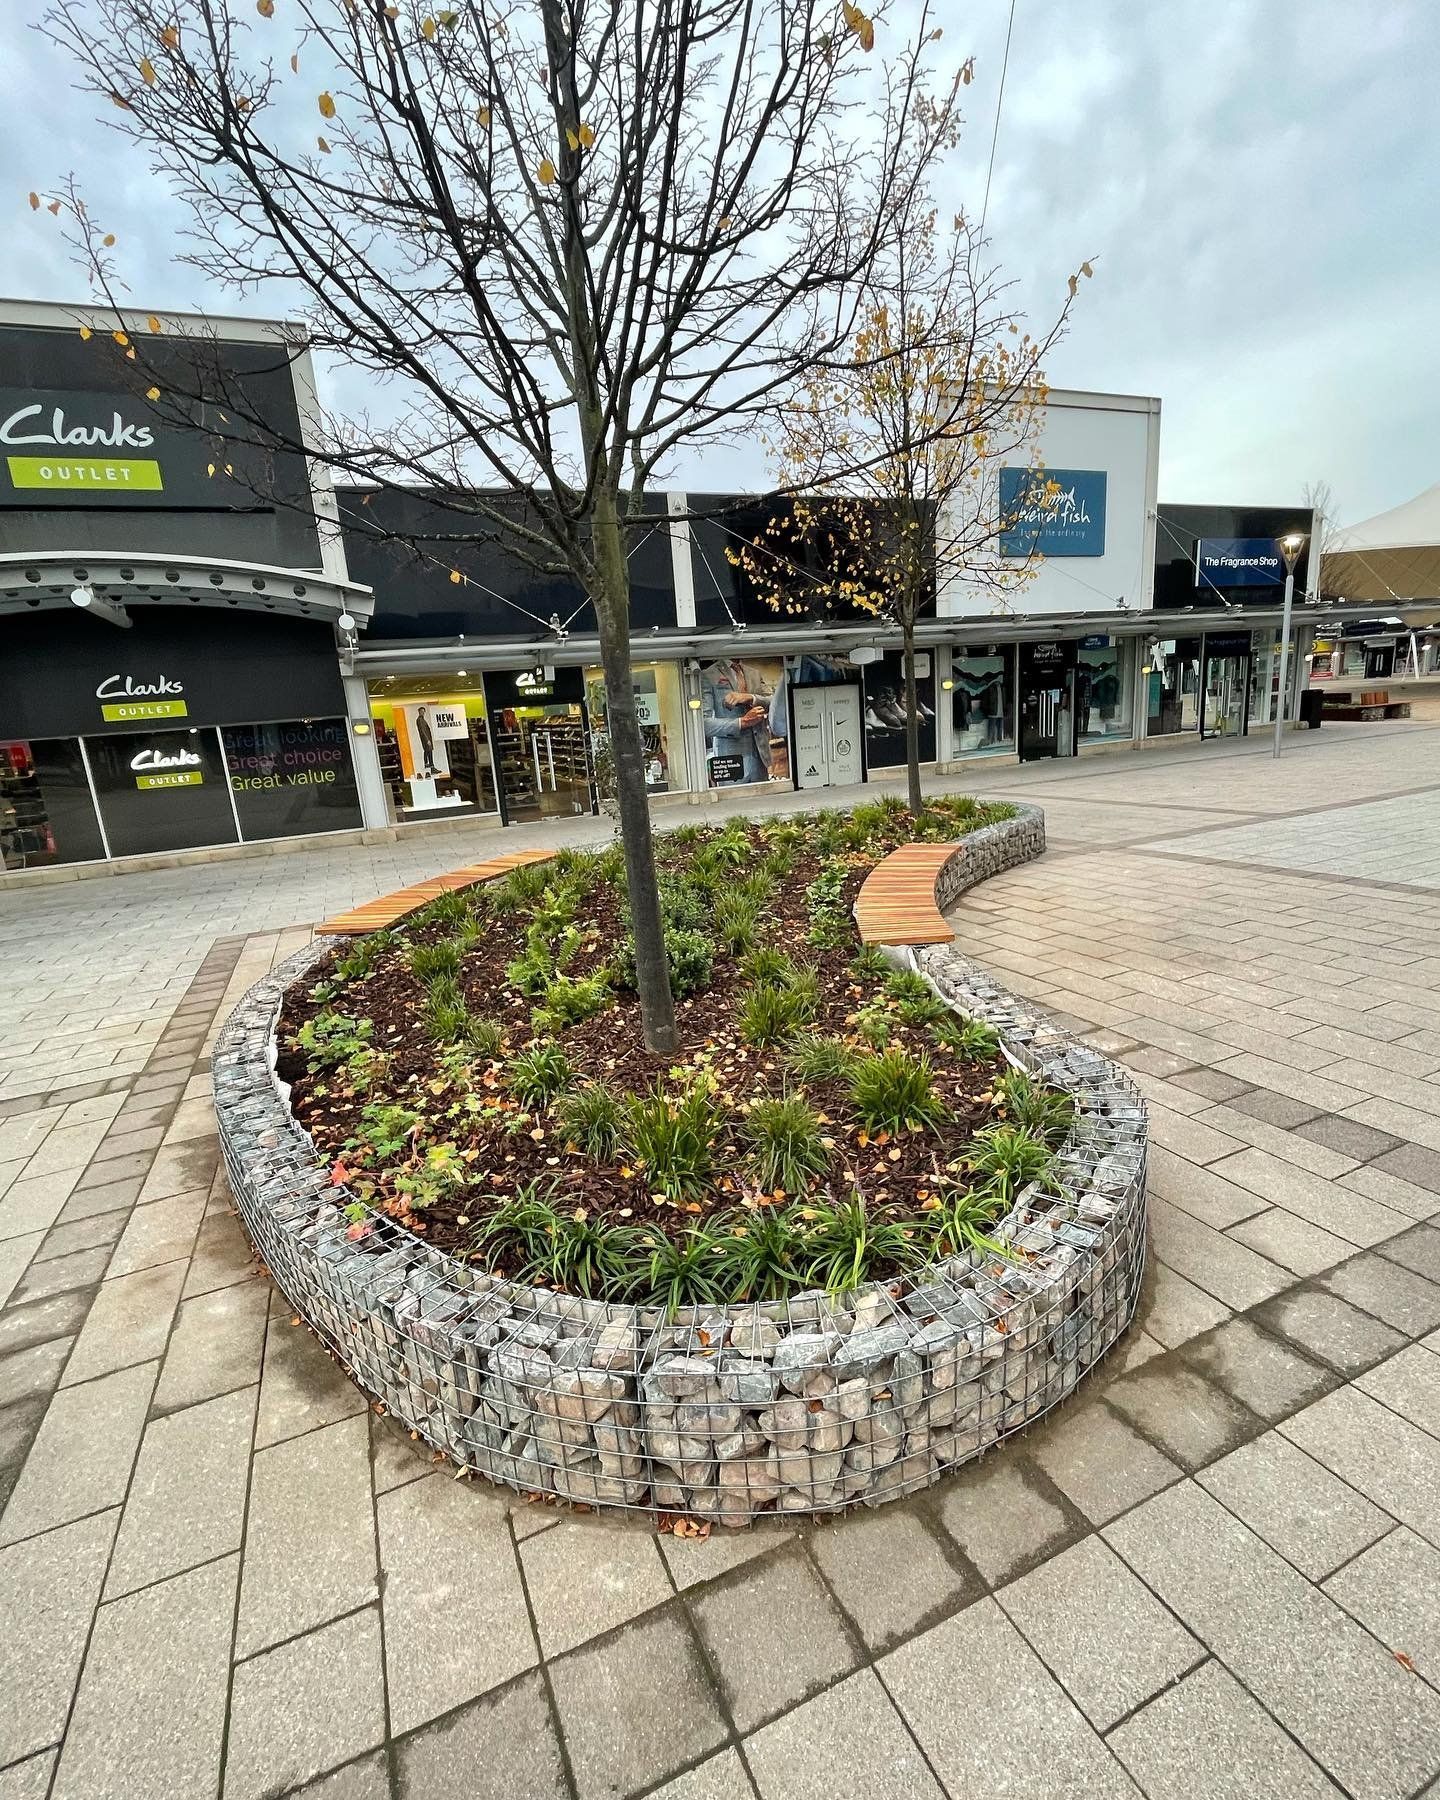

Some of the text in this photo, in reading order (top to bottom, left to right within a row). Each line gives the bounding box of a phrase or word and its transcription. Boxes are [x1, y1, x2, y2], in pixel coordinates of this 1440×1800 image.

[0, 404, 154, 448] Clarks
[39, 466, 131, 481] OUTLET
[1060, 500, 1090, 526] fish
[1204, 556, 1278, 569] The Fragrance Shop
[96, 674, 184, 698] Clarks
[118, 705, 172, 716] OUTLET
[436, 712, 454, 722] NEW
[224, 728, 346, 748] Great looking
[130, 748, 202, 770] Clarks
[227, 748, 342, 770] Great choice
[148, 775, 191, 786] OUTLET
[230, 770, 335, 790] Great value
